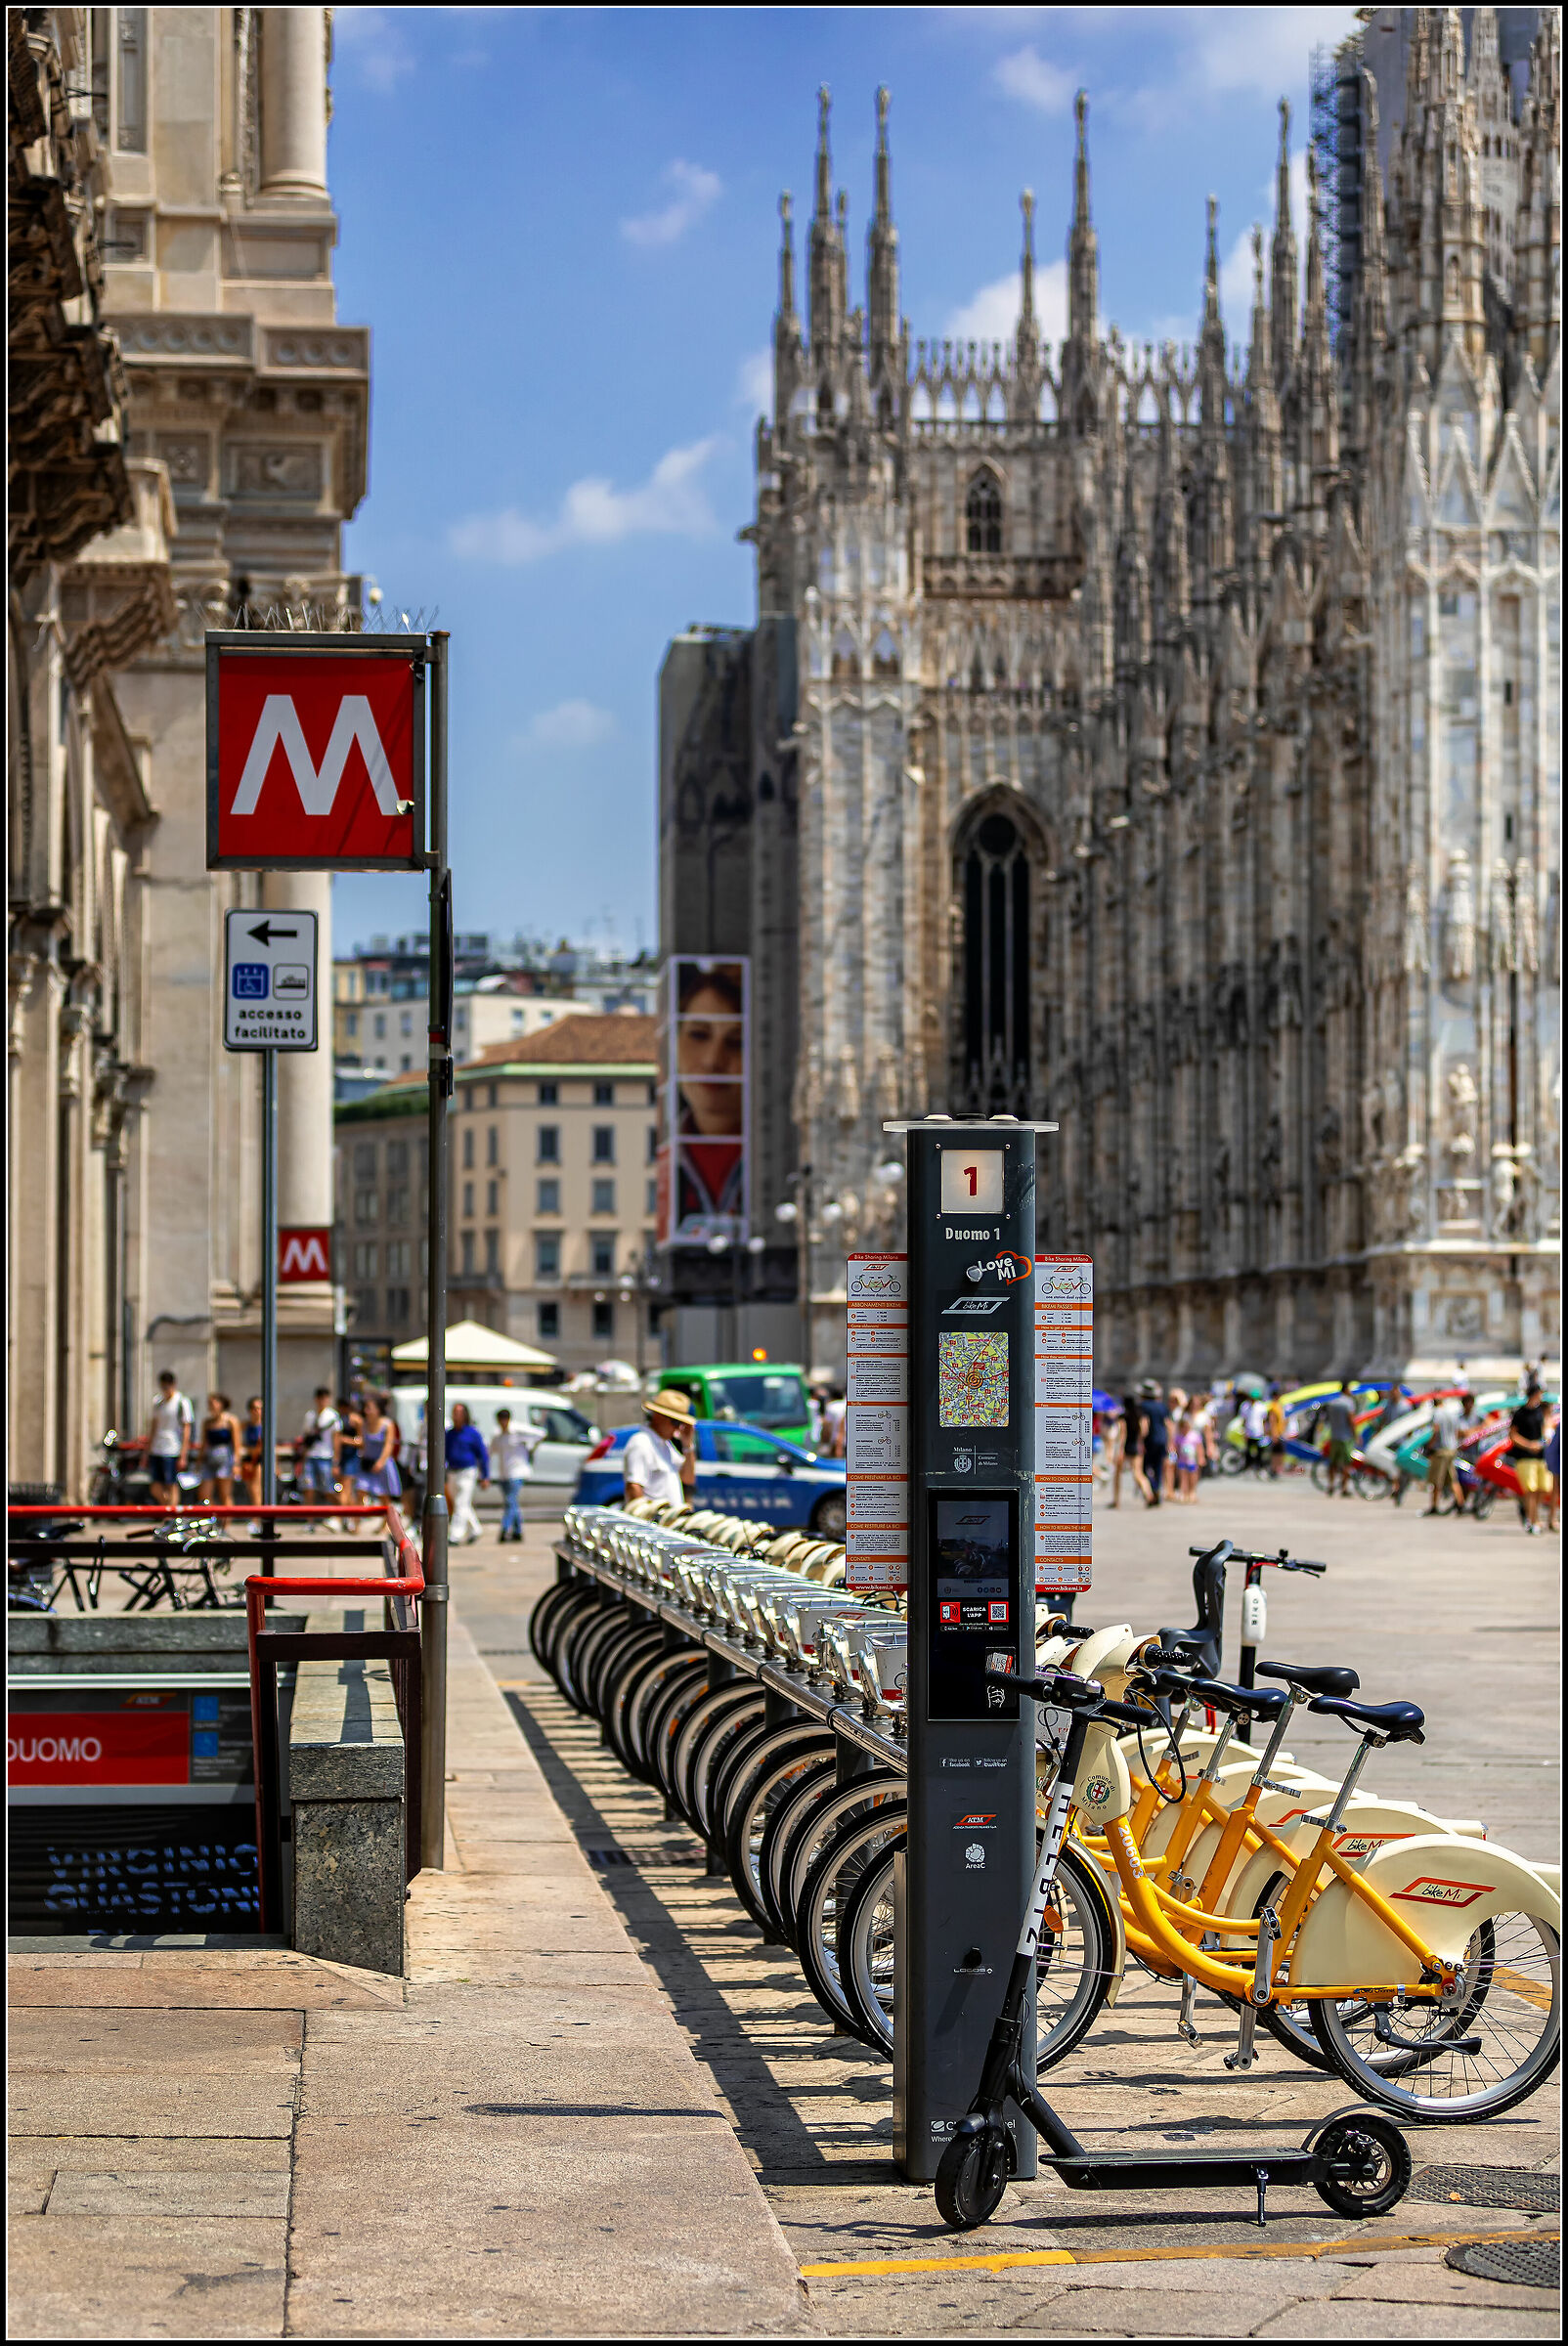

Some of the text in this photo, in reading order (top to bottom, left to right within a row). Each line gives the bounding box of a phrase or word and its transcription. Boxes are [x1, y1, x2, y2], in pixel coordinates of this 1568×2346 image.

[230, 694, 404, 816] M
[239, 1009, 302, 1020] accesso
[235, 1026, 306, 1039] facilitato
[963, 1166, 978, 1196] 1
[945, 1227, 1000, 1240] Duomo 1
[282, 1238, 326, 1273] M
[978, 1257, 1013, 1272] Love
[998, 1265, 1016, 1281] MI
[1087, 1775, 1112, 1784] Comune
[1081, 1796, 1107, 1810] Milano
[1118, 1825, 1144, 1879] 20603
[1347, 1839, 1385, 1852] bikeMi
[1026, 1794, 1071, 1944] HELBIZ
[1421, 1884, 1462, 1901] bikeMi
